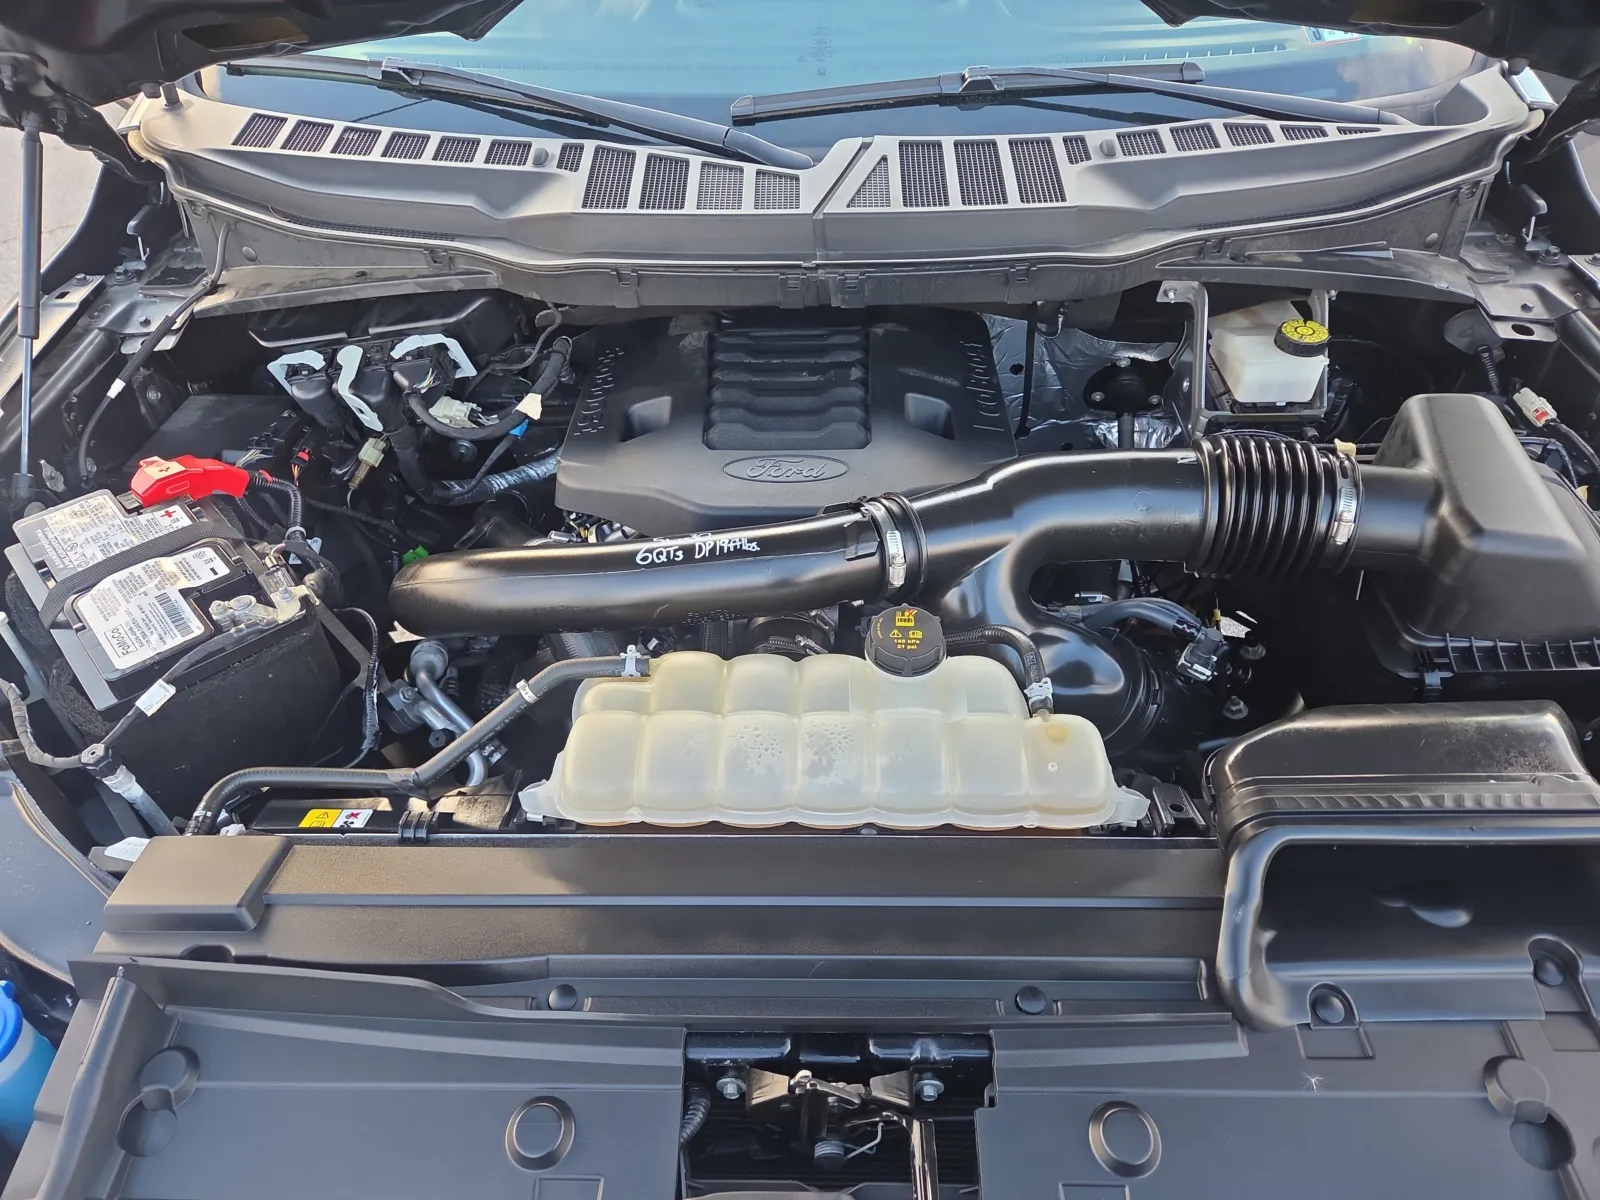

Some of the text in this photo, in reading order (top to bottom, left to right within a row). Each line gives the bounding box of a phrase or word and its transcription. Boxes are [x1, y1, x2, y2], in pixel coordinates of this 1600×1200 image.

[746, 458, 828, 479] Ford
[635, 545, 684, 565] 6QTs
[112, 628, 130, 655] FoMoCo
